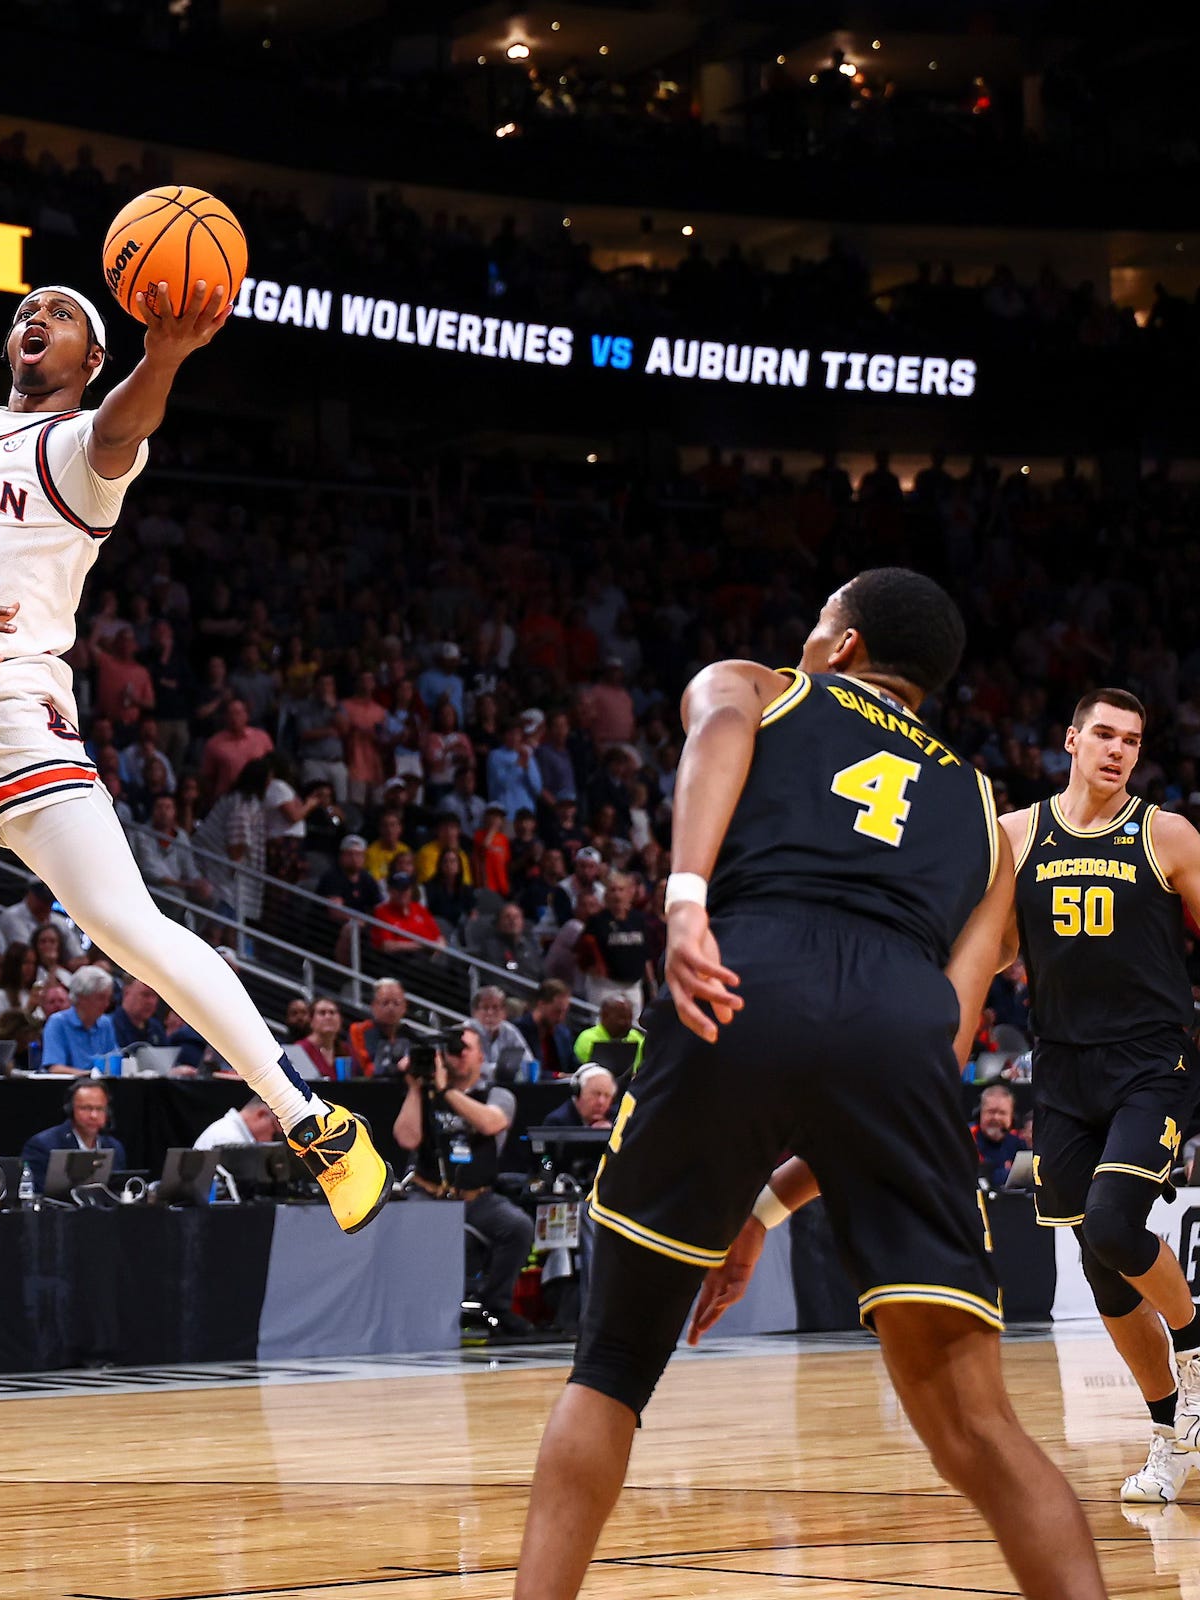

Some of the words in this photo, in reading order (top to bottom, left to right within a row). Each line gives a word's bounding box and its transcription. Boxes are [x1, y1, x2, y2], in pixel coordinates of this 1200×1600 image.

[233, 277, 333, 330] IGAN
[341, 293, 574, 366] WOLVERINES
[590, 334, 633, 370] VS
[644, 336, 810, 387] AUBURN
[821, 350, 977, 397] TIGERS
[826, 685, 962, 768] BURNETT
[830, 749, 922, 848] 4
[1035, 857, 1137, 884] MICHIGAN
[1051, 885, 1115, 937] 50
